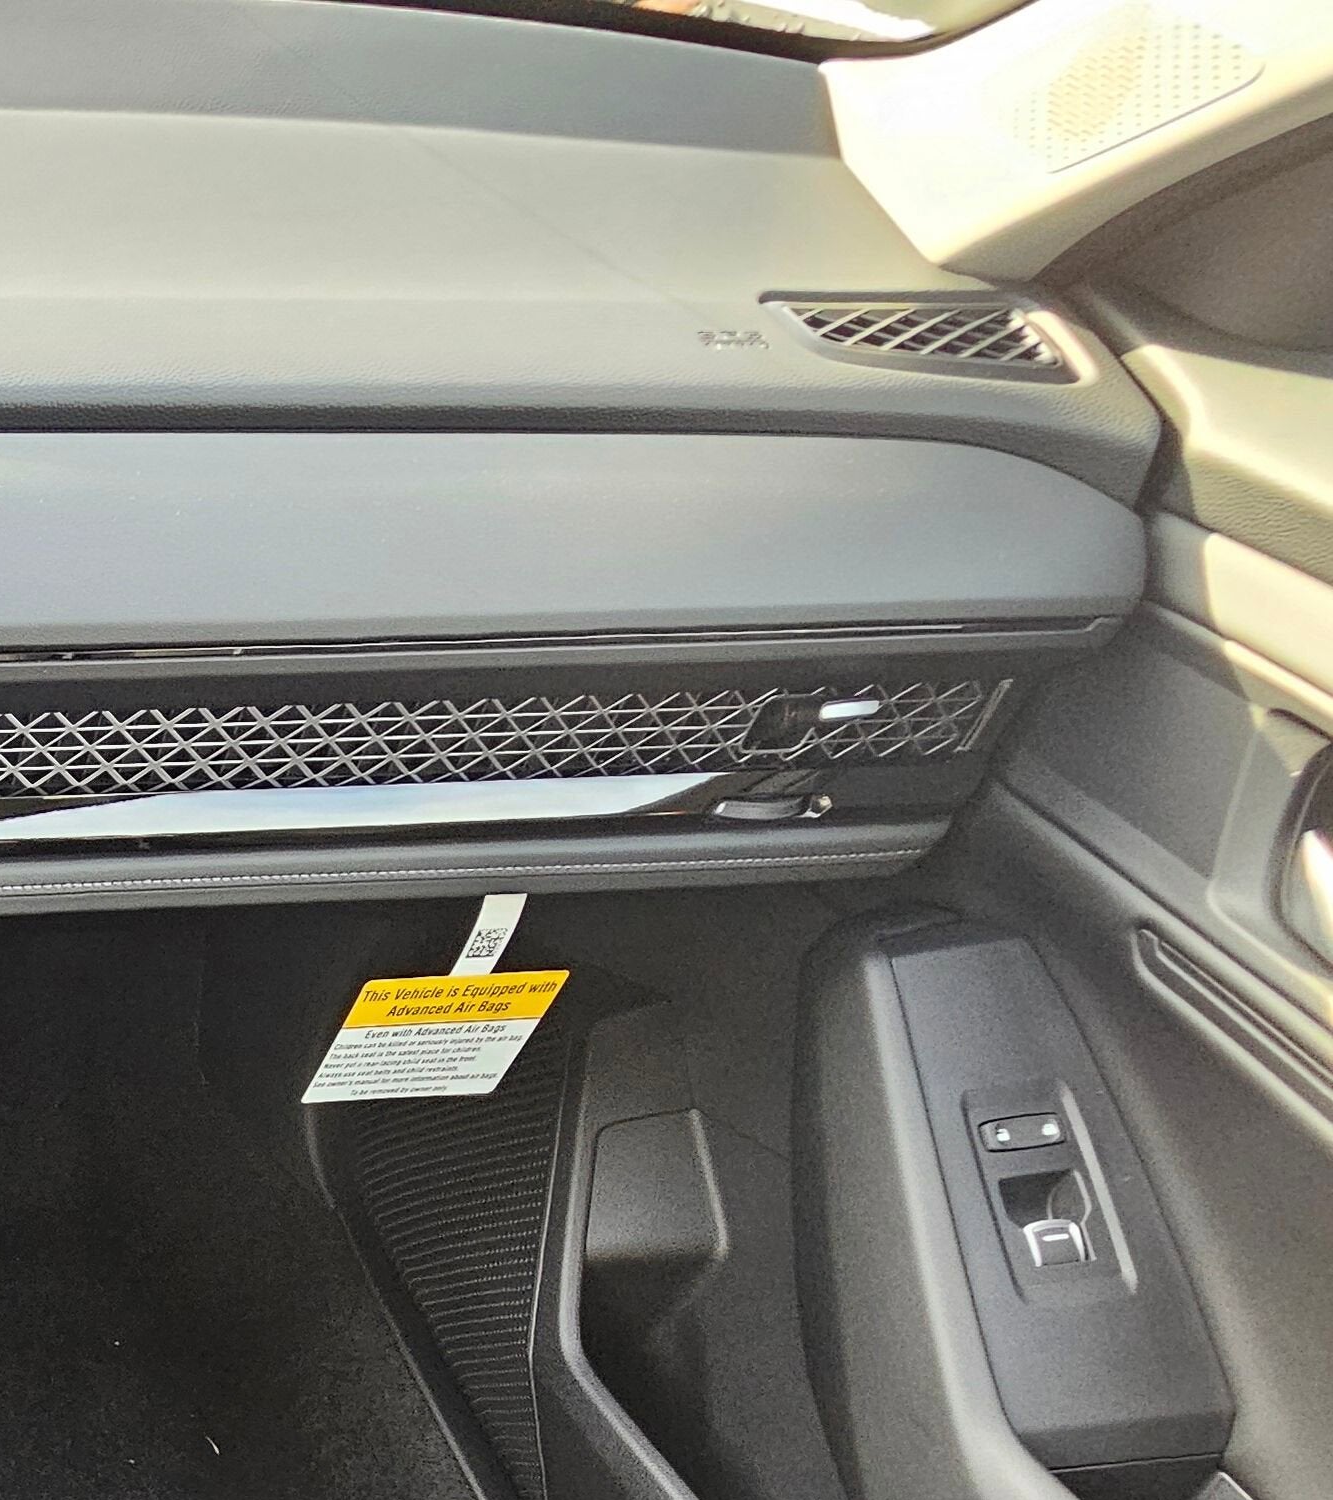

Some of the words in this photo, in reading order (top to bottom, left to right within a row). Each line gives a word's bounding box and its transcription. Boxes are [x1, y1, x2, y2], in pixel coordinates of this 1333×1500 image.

[363, 990, 391, 1003] This
[394, 986, 444, 1001] Vehicle
[446, 985, 459, 998] is
[461, 982, 527, 999] Equipped
[527, 980, 558, 994] with
[386, 1002, 454, 1017] Advanced
[453, 1000, 475, 1014] Air
[476, 999, 512, 1013] Bags
[365, 1029, 390, 1039] Even
[391, 1028, 413, 1037] with
[413, 1025, 464, 1037] Advanced
[463, 1024, 480, 1034] Air
[481, 1023, 507, 1034] Bags
